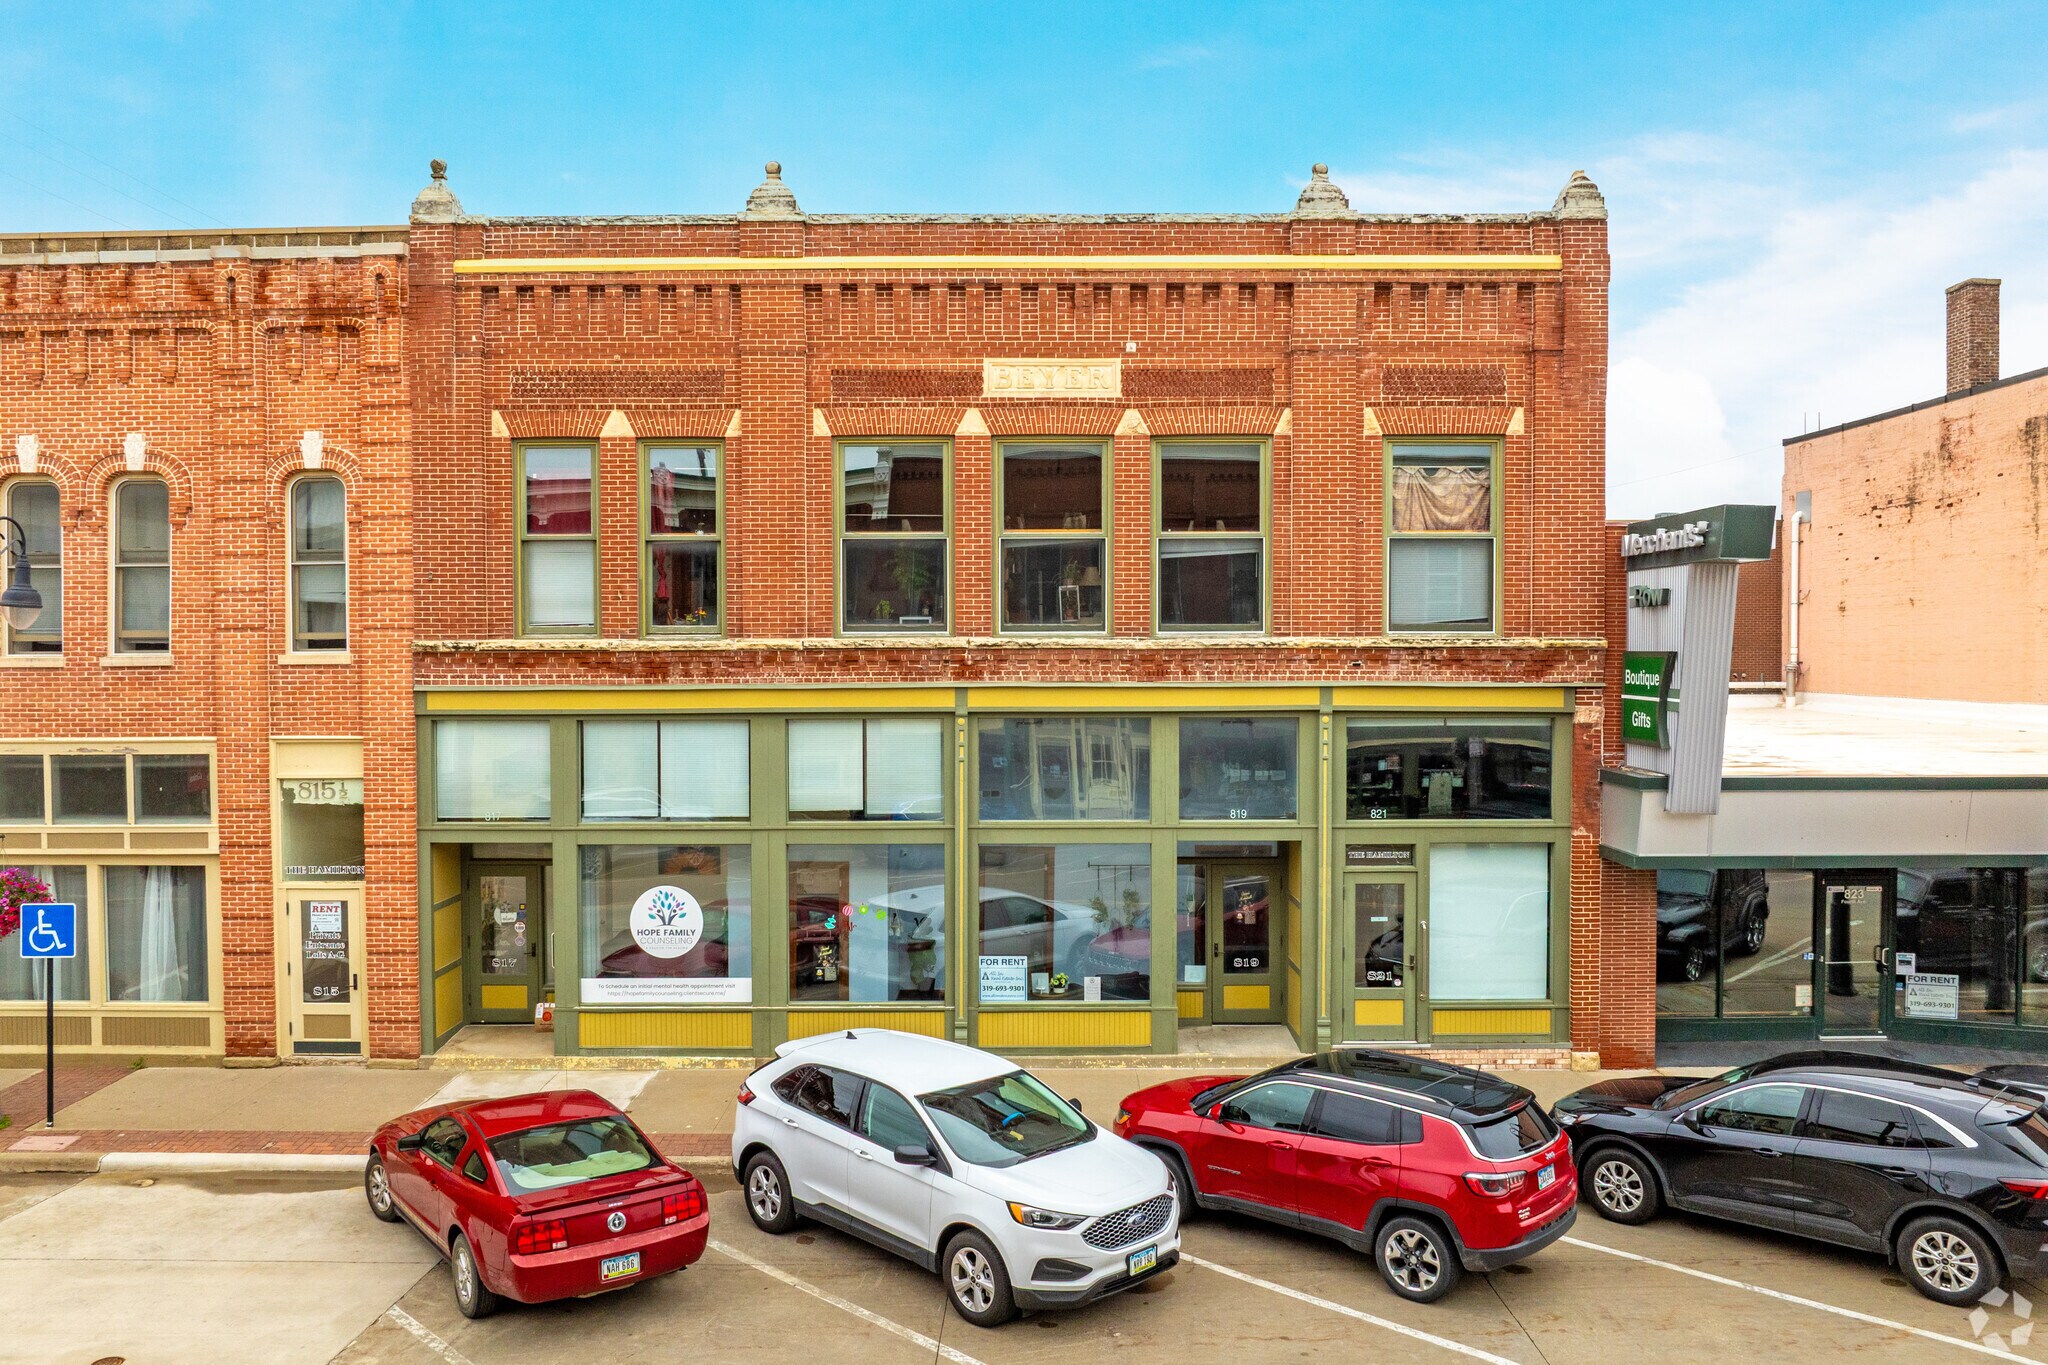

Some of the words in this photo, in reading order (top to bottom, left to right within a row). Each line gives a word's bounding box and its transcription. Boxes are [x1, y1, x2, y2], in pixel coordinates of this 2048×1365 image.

[994, 366, 1110, 390] BEYER
[1630, 585, 1667, 608] Row
[1625, 669, 1660, 689] Boutique
[1632, 711, 1651, 728] Gifts
[298, 781, 336, 800] 815
[1230, 809, 1247, 819] 819
[1370, 808, 1387, 819] 821
[1348, 851, 1365, 859] THE
[1366, 851, 1410, 859] HAMILTON
[285, 865, 307, 875] THE
[308, 865, 366, 875] HAMILTON
[1844, 889, 1864, 899] 823
[312, 905, 341, 913] RENT
[309, 930, 342, 940] Private
[305, 940, 346, 950] Entrance
[640, 937, 693, 945] COUNSELING
[491, 957, 517, 968] 817
[980, 958, 999, 966] FOR
[1001, 958, 1026, 966] RENT
[1233, 957, 1260, 968] 819
[1366, 970, 1393, 981] 821
[1930, 976, 1957, 984] RENT
[313, 986, 340, 996] 815
[1909, 1000, 1955, 1009] 319-693-9301
[606, 1262, 620, 1274] NAH
[621, 1258, 635, 1271] 686
